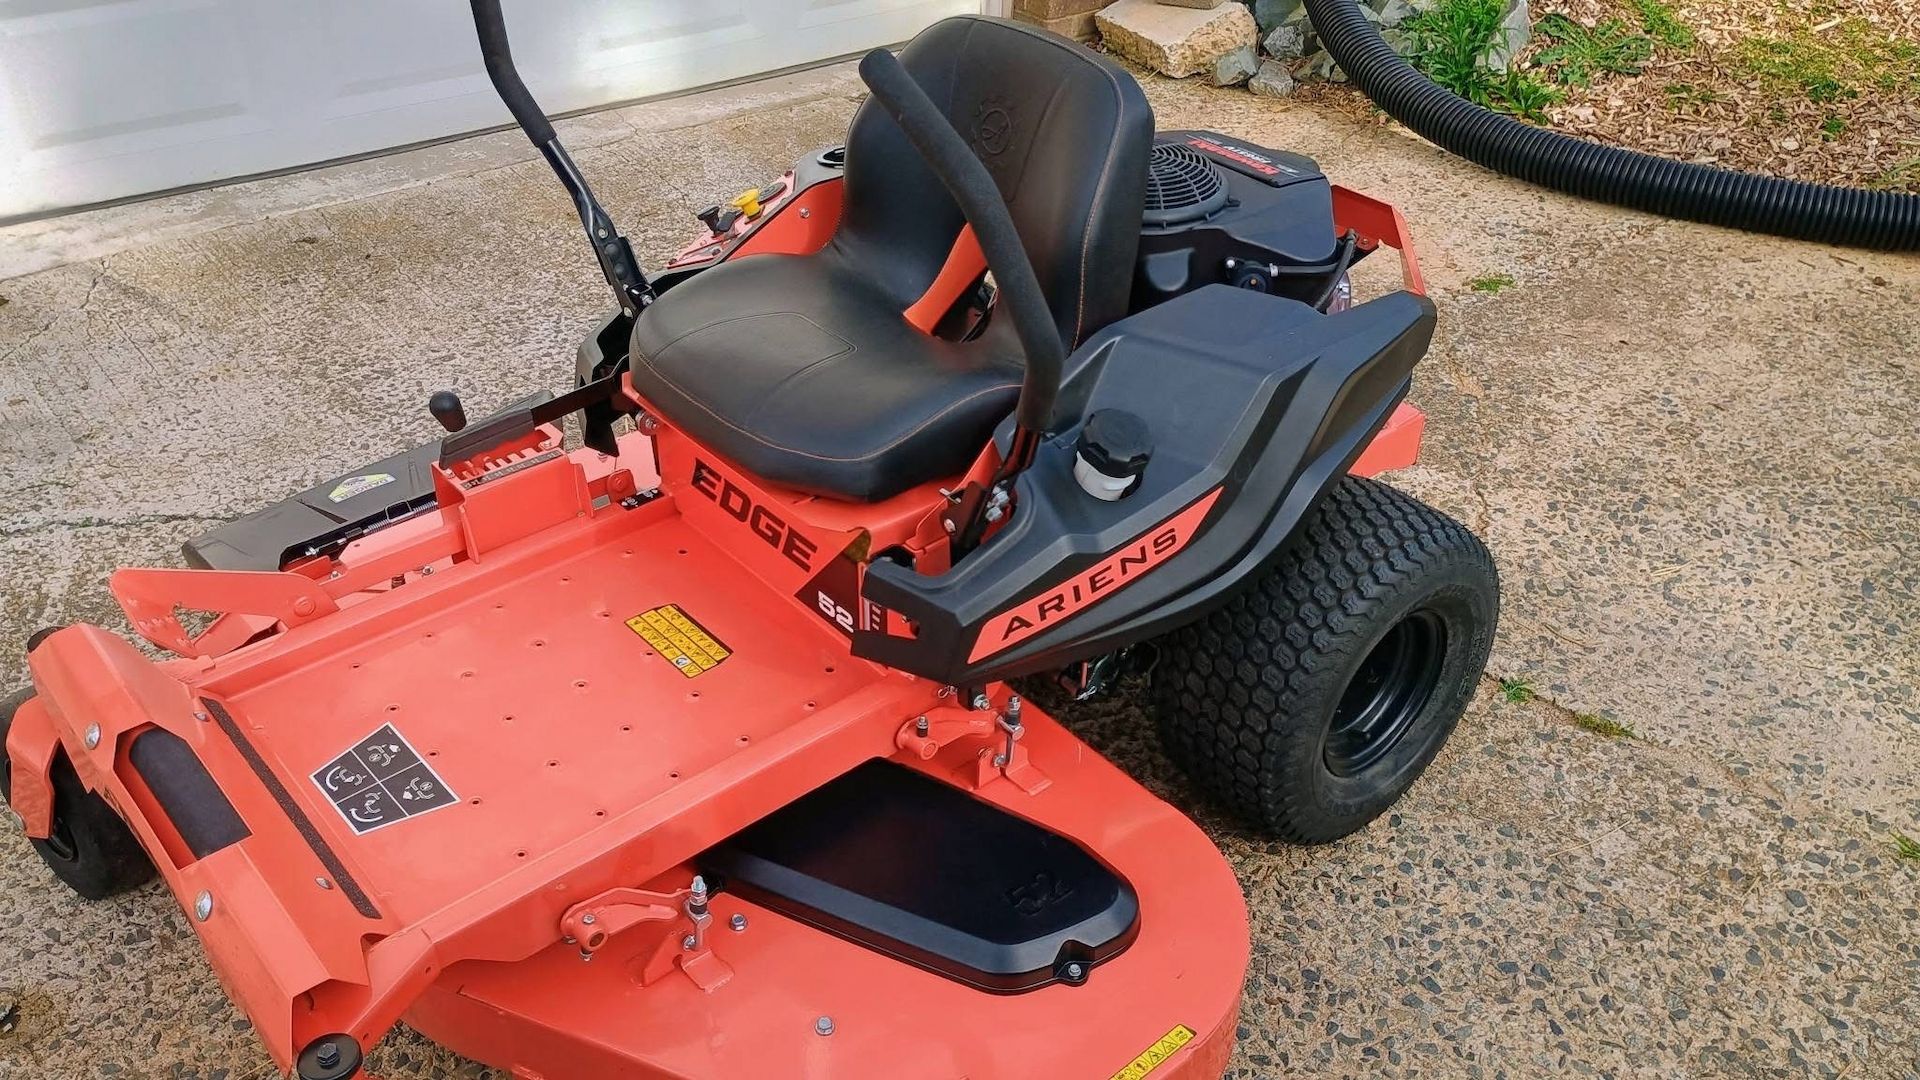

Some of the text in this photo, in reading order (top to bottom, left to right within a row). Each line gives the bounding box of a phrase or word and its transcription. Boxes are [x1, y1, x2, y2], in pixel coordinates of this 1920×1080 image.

[691, 457, 818, 573] EDGE
[817, 590, 854, 632] 52
[1001, 528, 1177, 641] ARIENS
